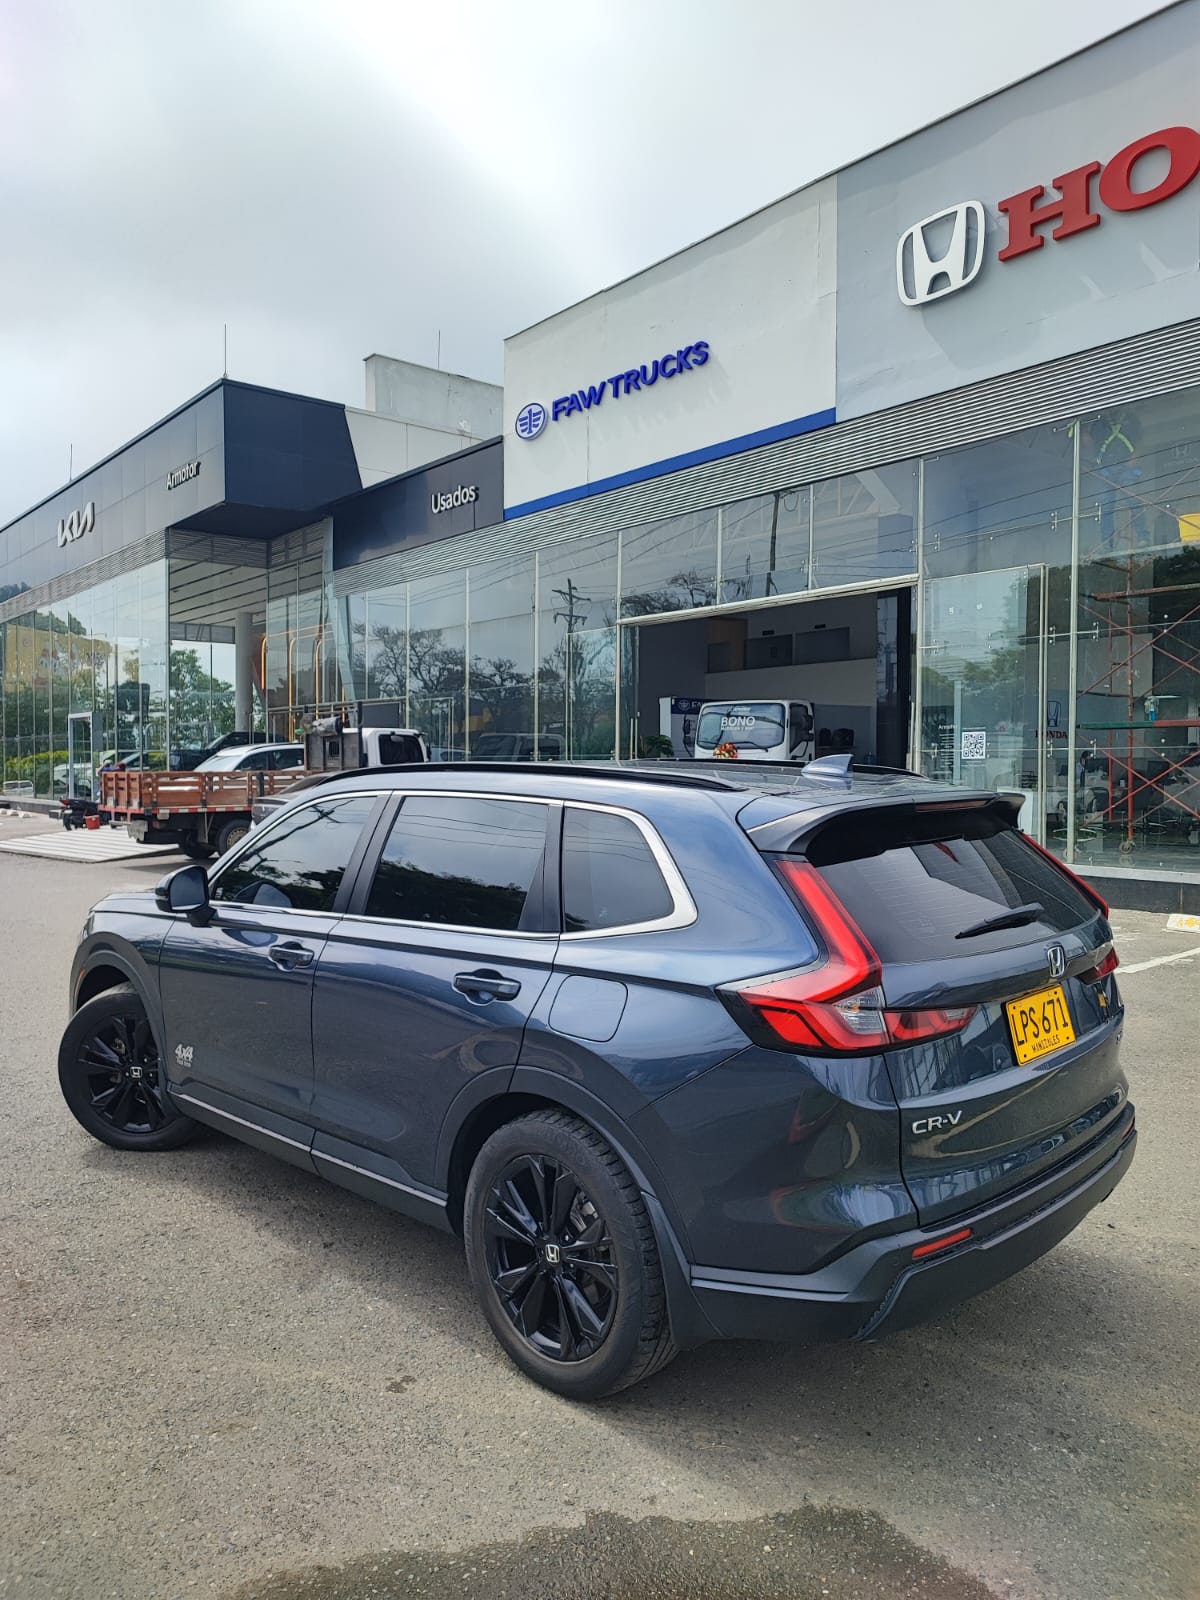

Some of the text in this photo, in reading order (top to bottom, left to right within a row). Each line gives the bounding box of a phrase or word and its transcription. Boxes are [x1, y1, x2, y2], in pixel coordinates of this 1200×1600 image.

[998, 126, 1200, 262] HO
[551, 341, 709, 422] FAW TRUCKS
[166, 461, 201, 490] Armotor
[431, 484, 479, 514] Usados
[721, 716, 756, 727] BONO
[1011, 997, 1069, 1046] LPS 671
[912, 1110, 963, 1134] CR-V
